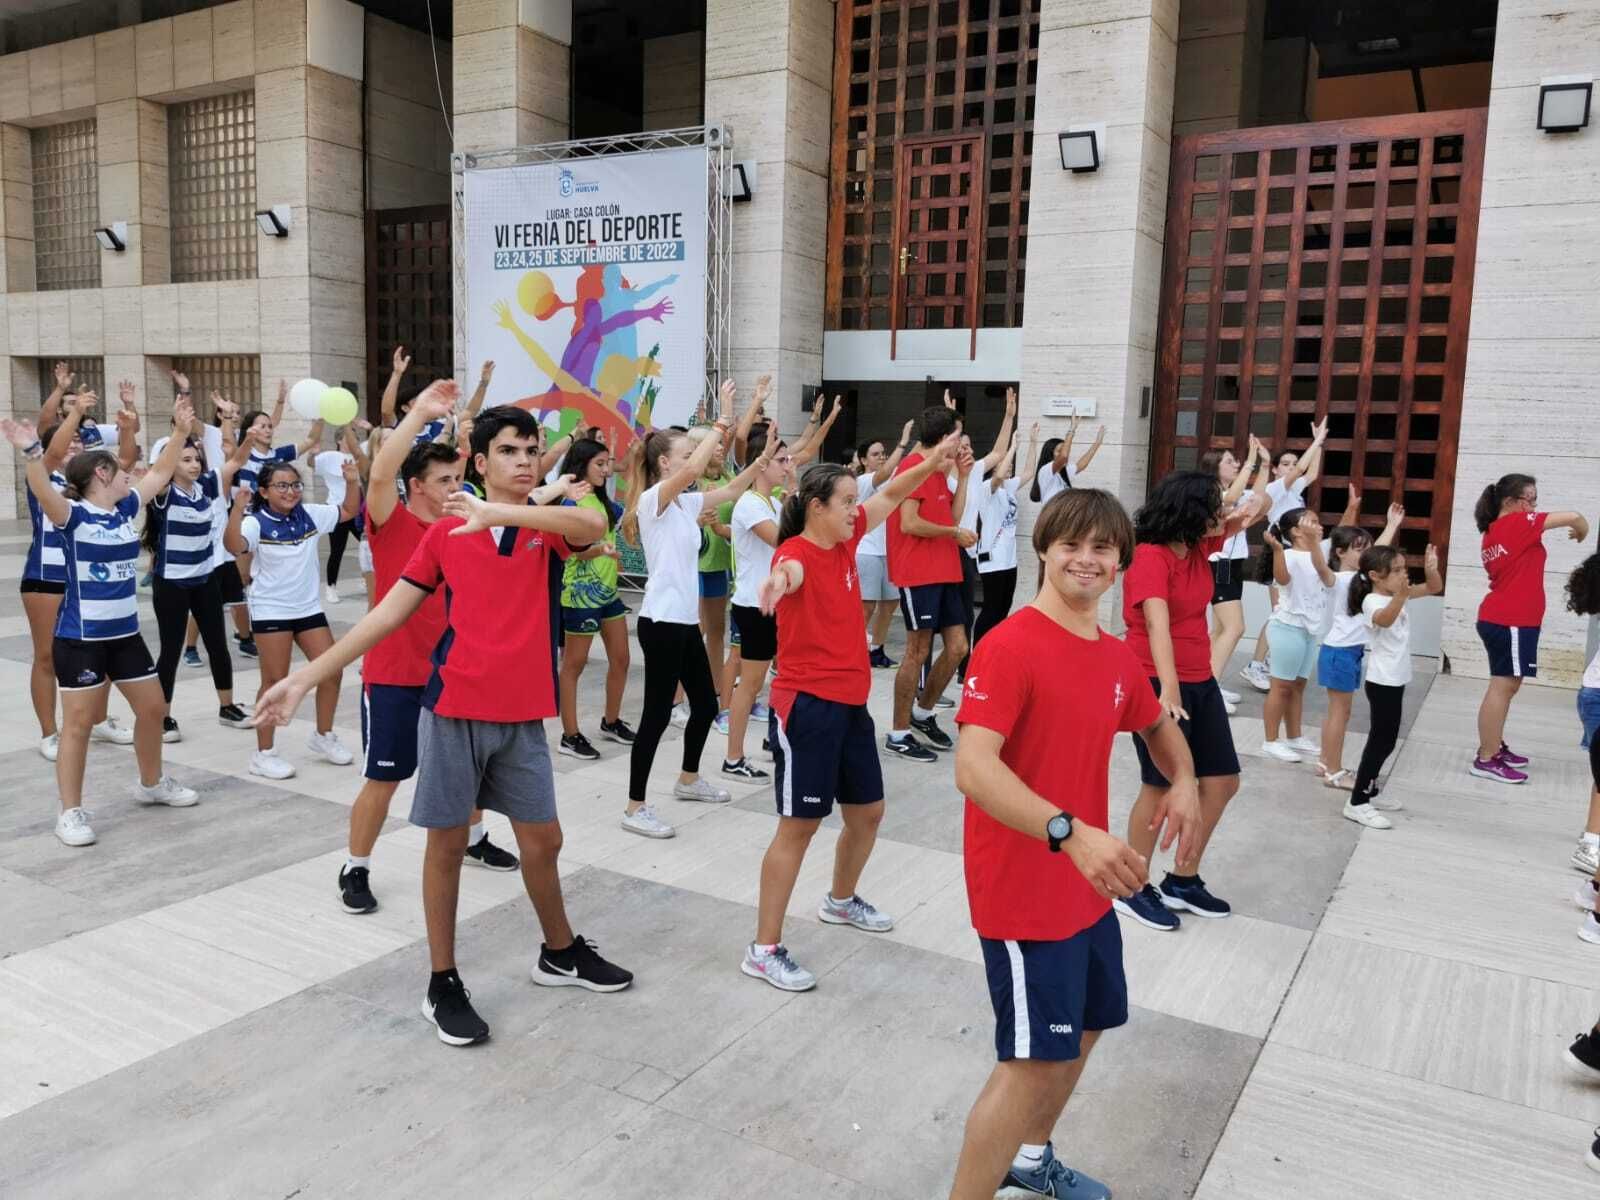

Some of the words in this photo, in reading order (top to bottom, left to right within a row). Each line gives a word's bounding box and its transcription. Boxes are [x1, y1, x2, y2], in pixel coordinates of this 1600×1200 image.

[546, 208, 571, 220] LUGAR:
[574, 206, 594, 218] CASA
[595, 204, 620, 217] COLÓN
[495, 224, 509, 248] VI
[514, 221, 560, 248] FERIA
[565, 219, 597, 245] DEL
[602, 212, 682, 243] DEPORTE
[544, 249, 559, 265] DE
[560, 246, 628, 264] SEPTIEMBRE
[629, 245, 644, 261] DE
[647, 243, 677, 260] 2022
